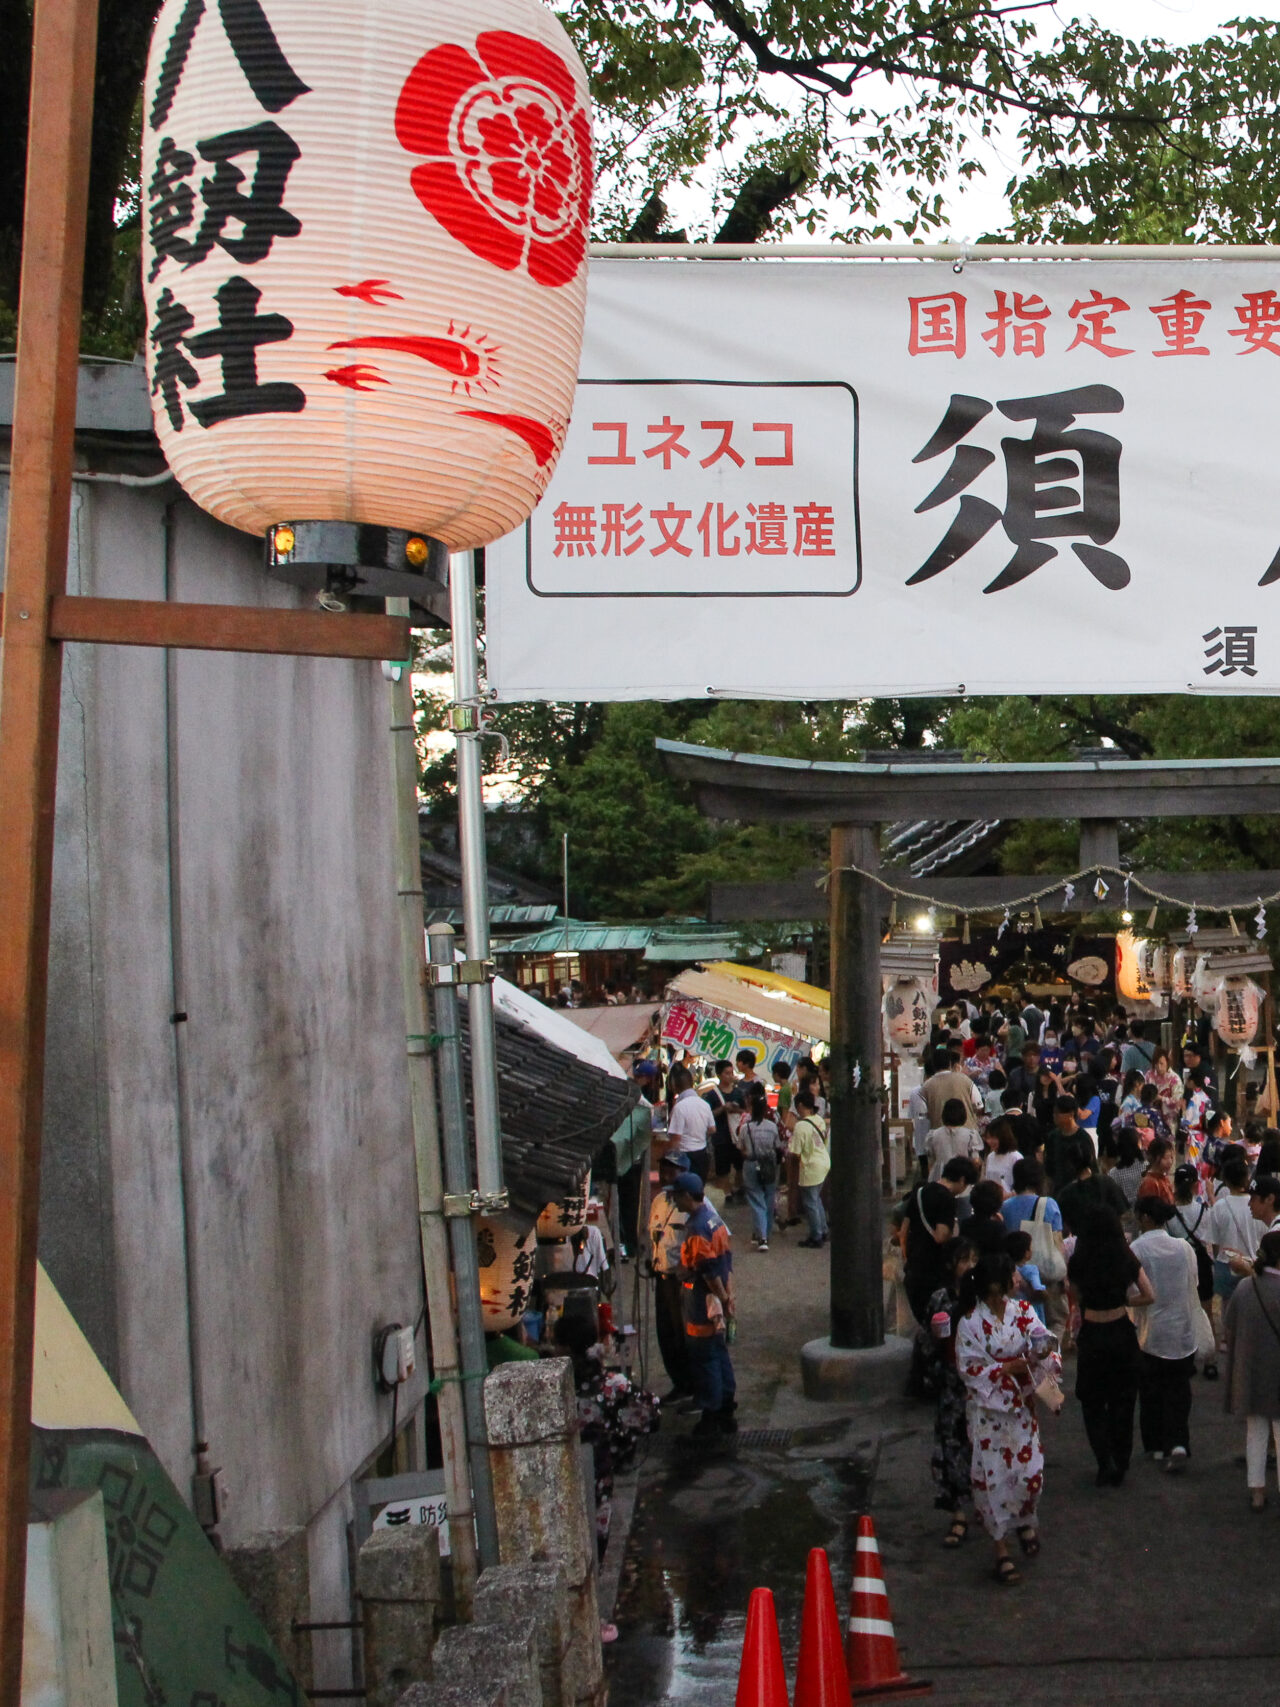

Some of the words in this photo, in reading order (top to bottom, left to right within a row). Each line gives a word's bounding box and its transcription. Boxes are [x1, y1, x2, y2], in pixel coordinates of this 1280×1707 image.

[587, 415, 795, 470] ユネスコ
[552, 501, 836, 559] 無形文化遺産
